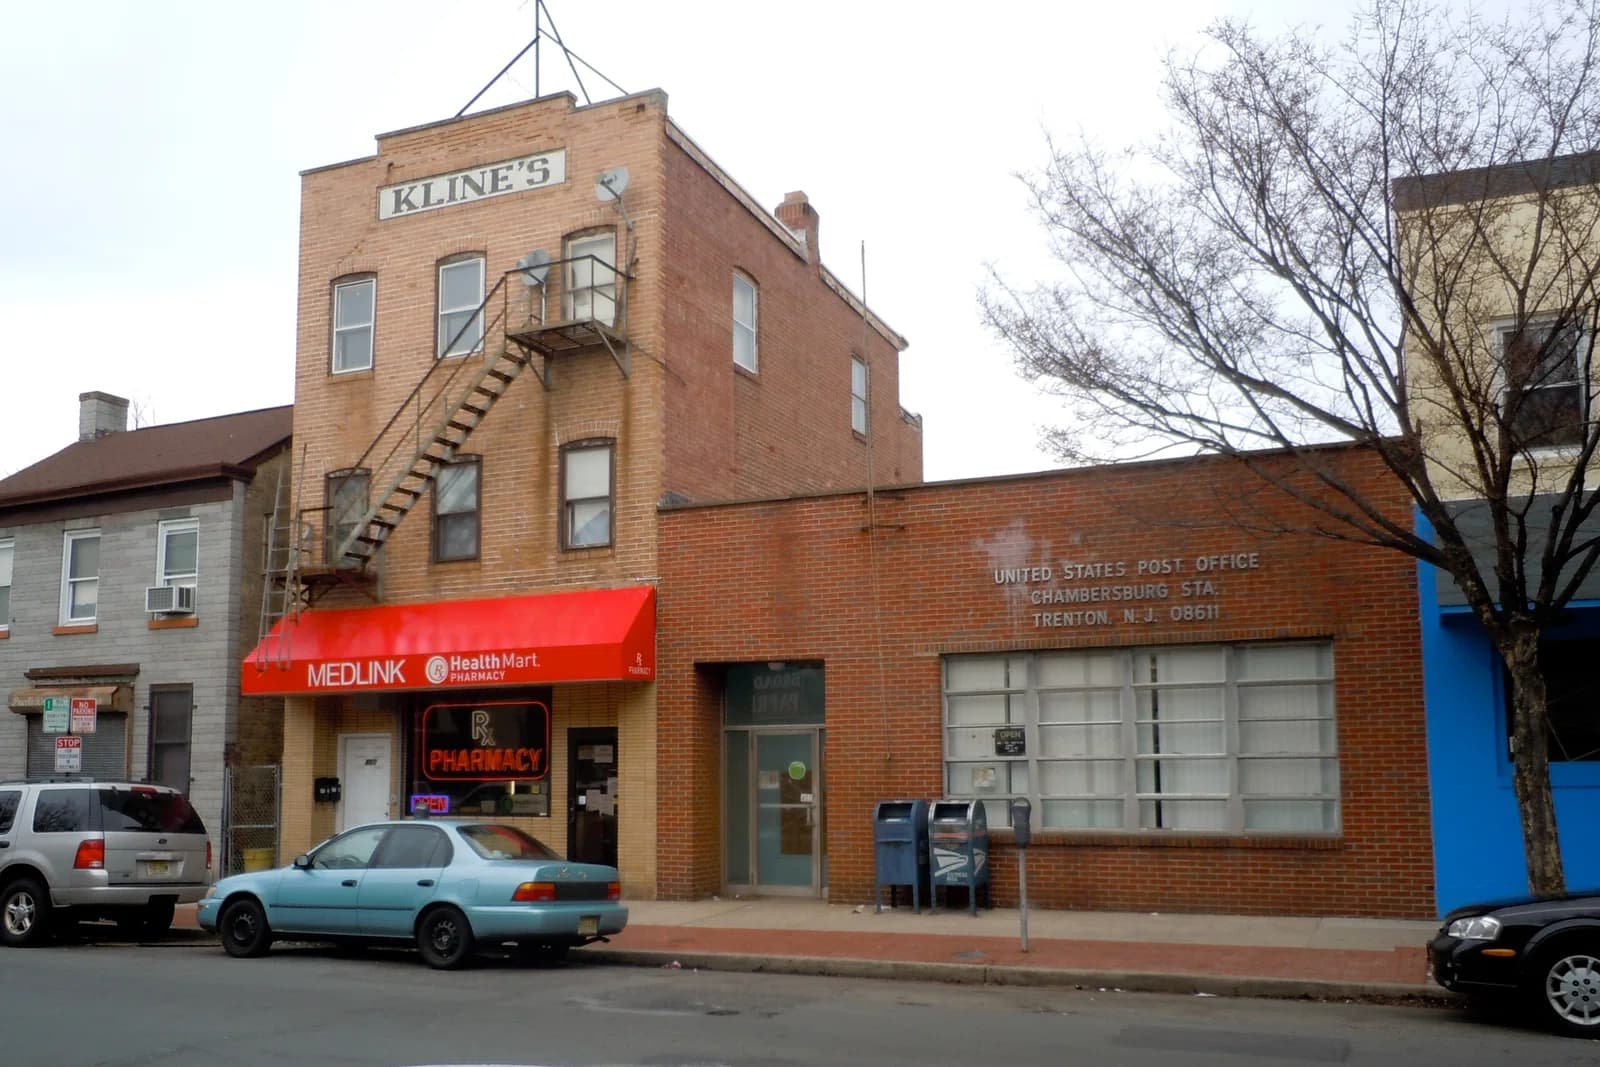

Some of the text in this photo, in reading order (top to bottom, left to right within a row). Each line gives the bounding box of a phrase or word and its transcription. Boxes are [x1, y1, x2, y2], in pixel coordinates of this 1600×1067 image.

[392, 157, 551, 214] KLINE'S
[994, 553, 1259, 585] UNITED STATES POST OFFICE
[1031, 581, 1219, 606] CHAMBERSBURG STA.
[1170, 604, 1219, 621] 08611
[450, 653, 500, 671] Health
[307, 659, 406, 687] MEDLINK
[450, 671, 506, 682] PHARMACY
[78, 701, 89, 709] NO
[57, 739, 80, 747] STOP
[430, 748, 542, 772] PHARMACY
